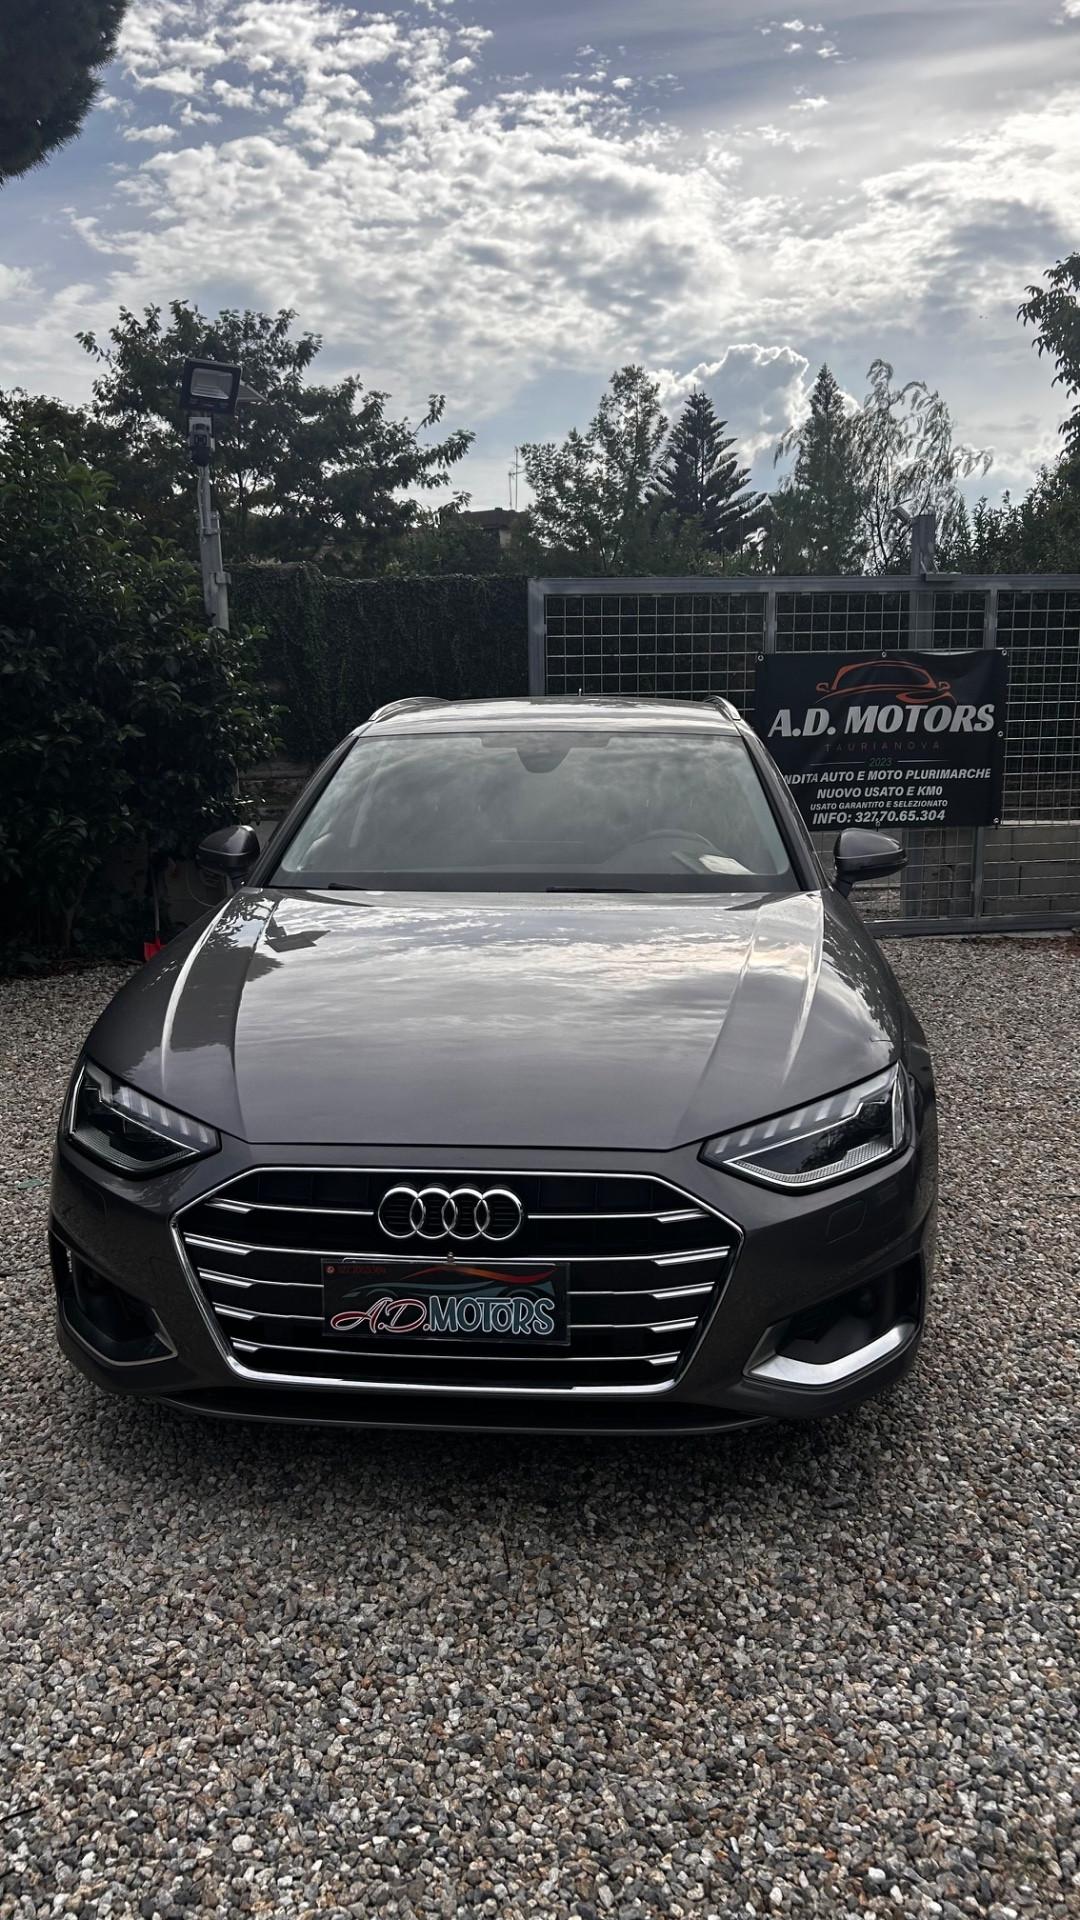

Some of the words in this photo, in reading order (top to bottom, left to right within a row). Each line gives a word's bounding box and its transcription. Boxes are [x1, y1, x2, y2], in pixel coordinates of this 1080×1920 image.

[768, 708, 836, 737] A.D.
[844, 703, 995, 734] MOTORS
[823, 740, 940, 752] TAURIANOVA
[868, 757, 893, 767] 2023
[820, 771, 854, 782] AUTO
[857, 770, 865, 781] E
[867, 769, 902, 781] MOTO
[905, 768, 991, 780] PLURIMARCHE
[817, 787, 861, 799] NUOVO
[864, 786, 904, 798] USATO
[907, 786, 915, 796] E
[810, 802, 836, 811] USATO
[838, 801, 884, 809] GARANTITO
[893, 799, 948, 808] SELEZIONATO
[812, 812, 851, 825] INFO:
